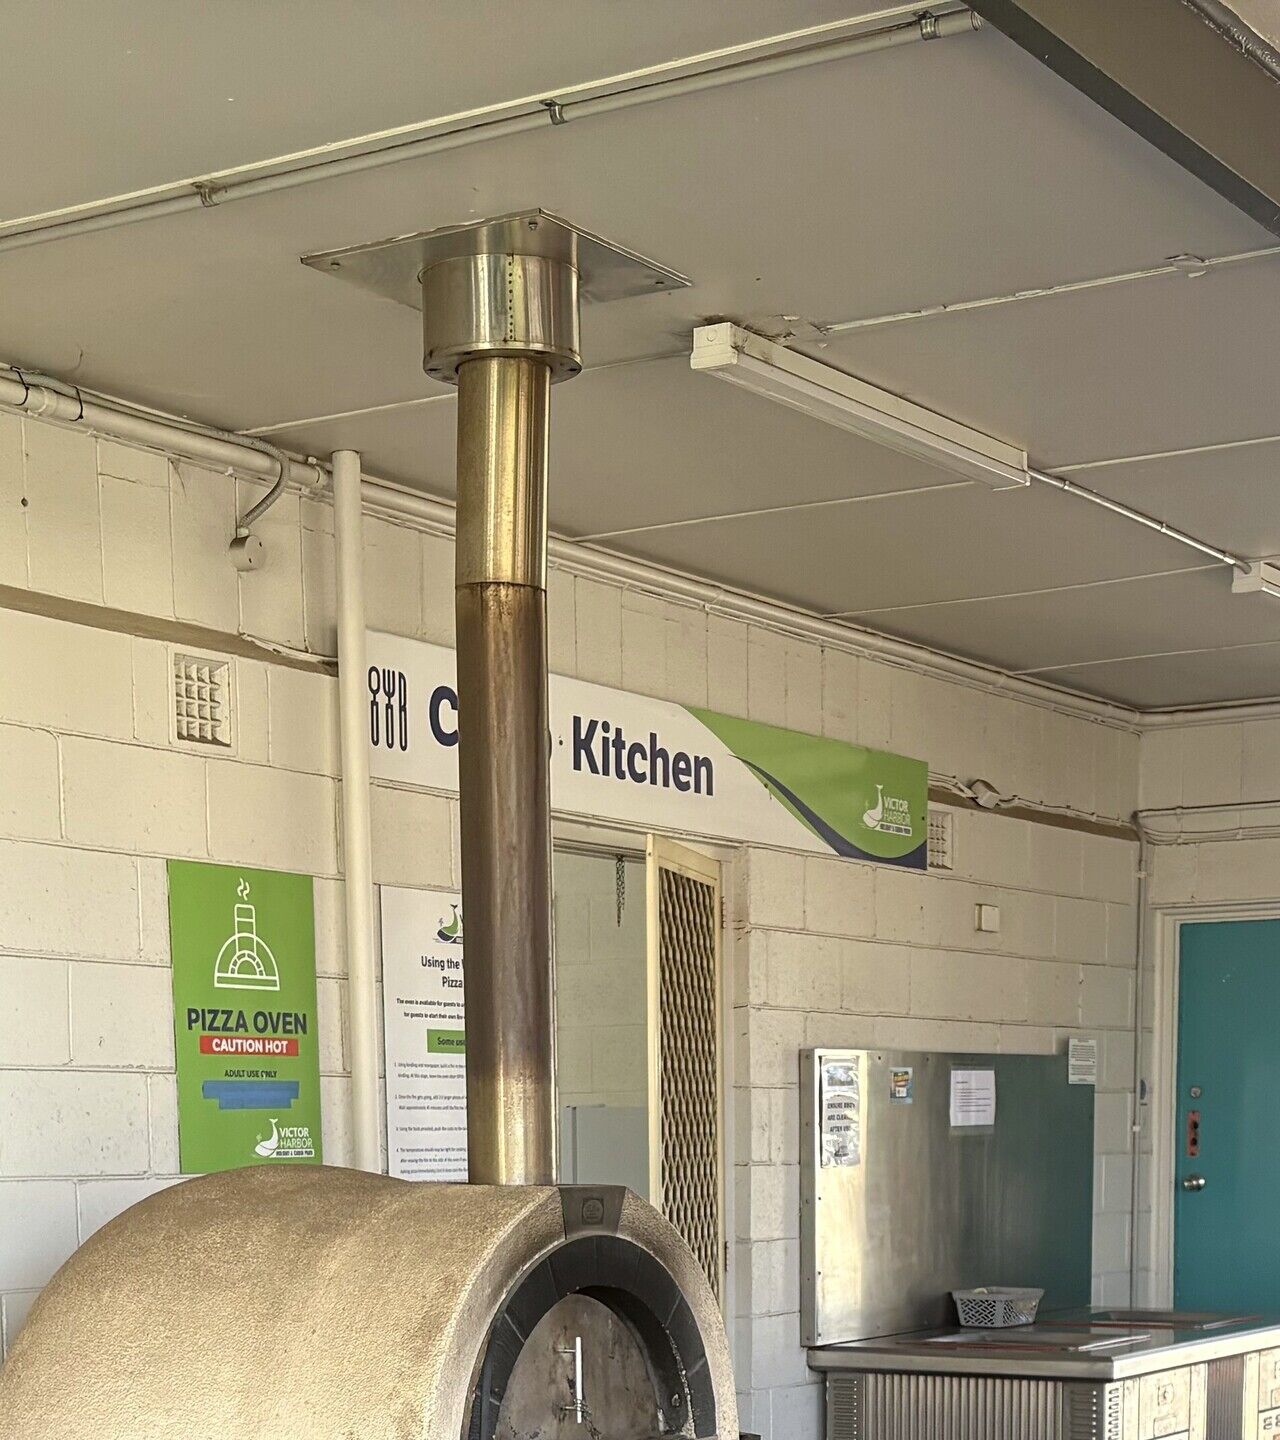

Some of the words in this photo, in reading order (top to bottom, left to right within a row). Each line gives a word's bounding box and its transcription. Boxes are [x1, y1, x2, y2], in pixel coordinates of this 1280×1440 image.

[572, 715, 714, 797] Kitchen
[421, 955, 445, 971] Using
[446, 958, 460, 970] the
[441, 976, 463, 988] Pizza
[187, 1007, 249, 1033] PIZZA
[253, 1010, 307, 1035] OVEN
[211, 1038, 264, 1053] CAUTION
[265, 1040, 288, 1053] HOT
[437, 1036, 455, 1046] Some
[224, 1068, 246, 1078] ADULT
[246, 1069, 260, 1078] USE
[279, 1127, 310, 1138] VICTOR
[279, 1137, 313, 1148] HARBOR
